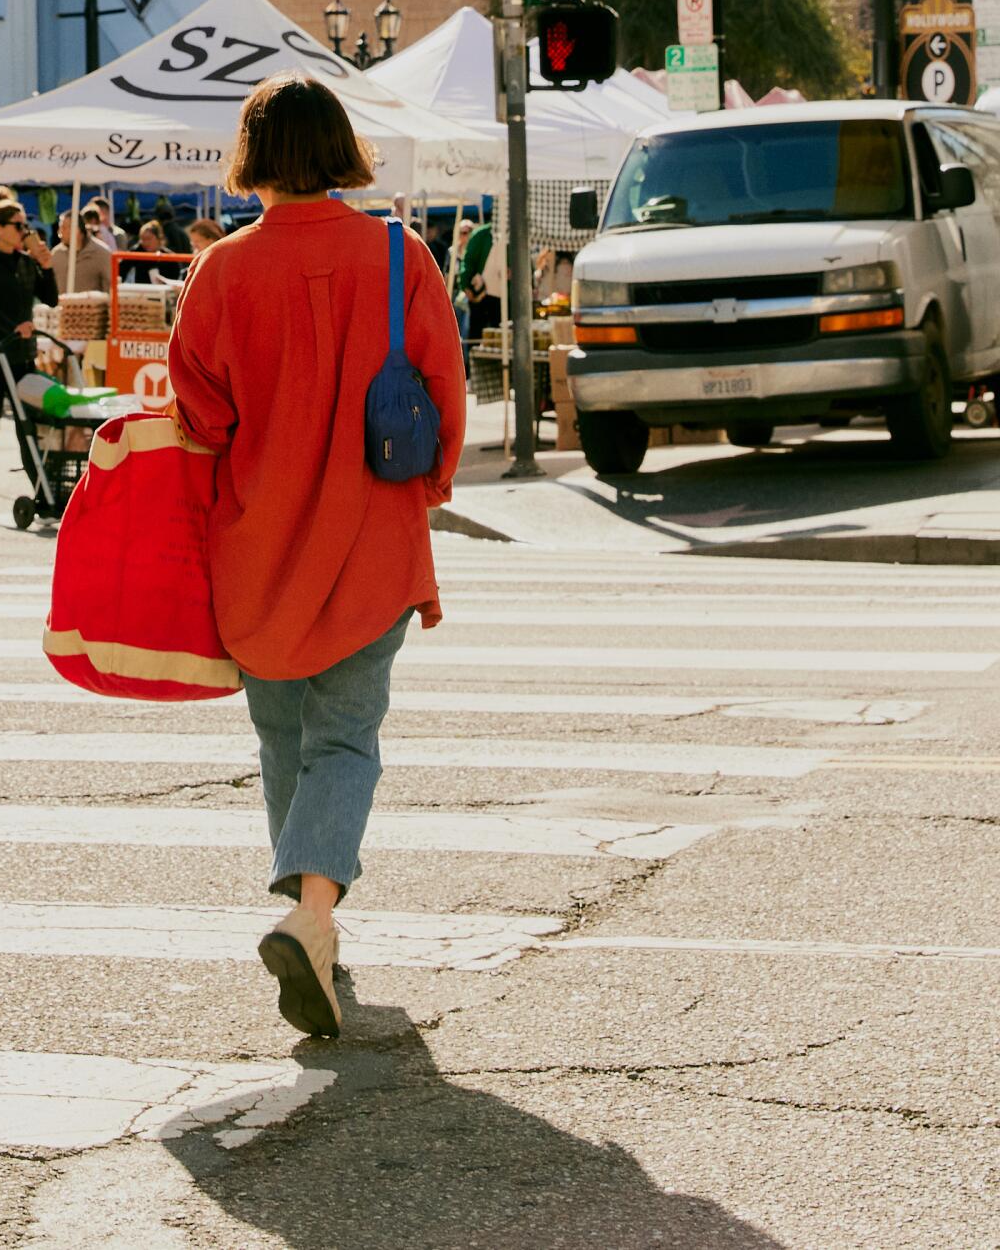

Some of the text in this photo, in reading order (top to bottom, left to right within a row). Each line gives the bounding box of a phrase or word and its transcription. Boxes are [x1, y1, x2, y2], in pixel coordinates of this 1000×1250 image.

[906, 13, 970, 28] HOLLYWOOD
[158, 26, 280, 86] SZ
[671, 49, 681, 66] 2
[934, 70, 945, 96] P
[48, 144, 88, 169] Eggs
[108, 132, 144, 161] SZ
[123, 342, 166, 359] MERID
